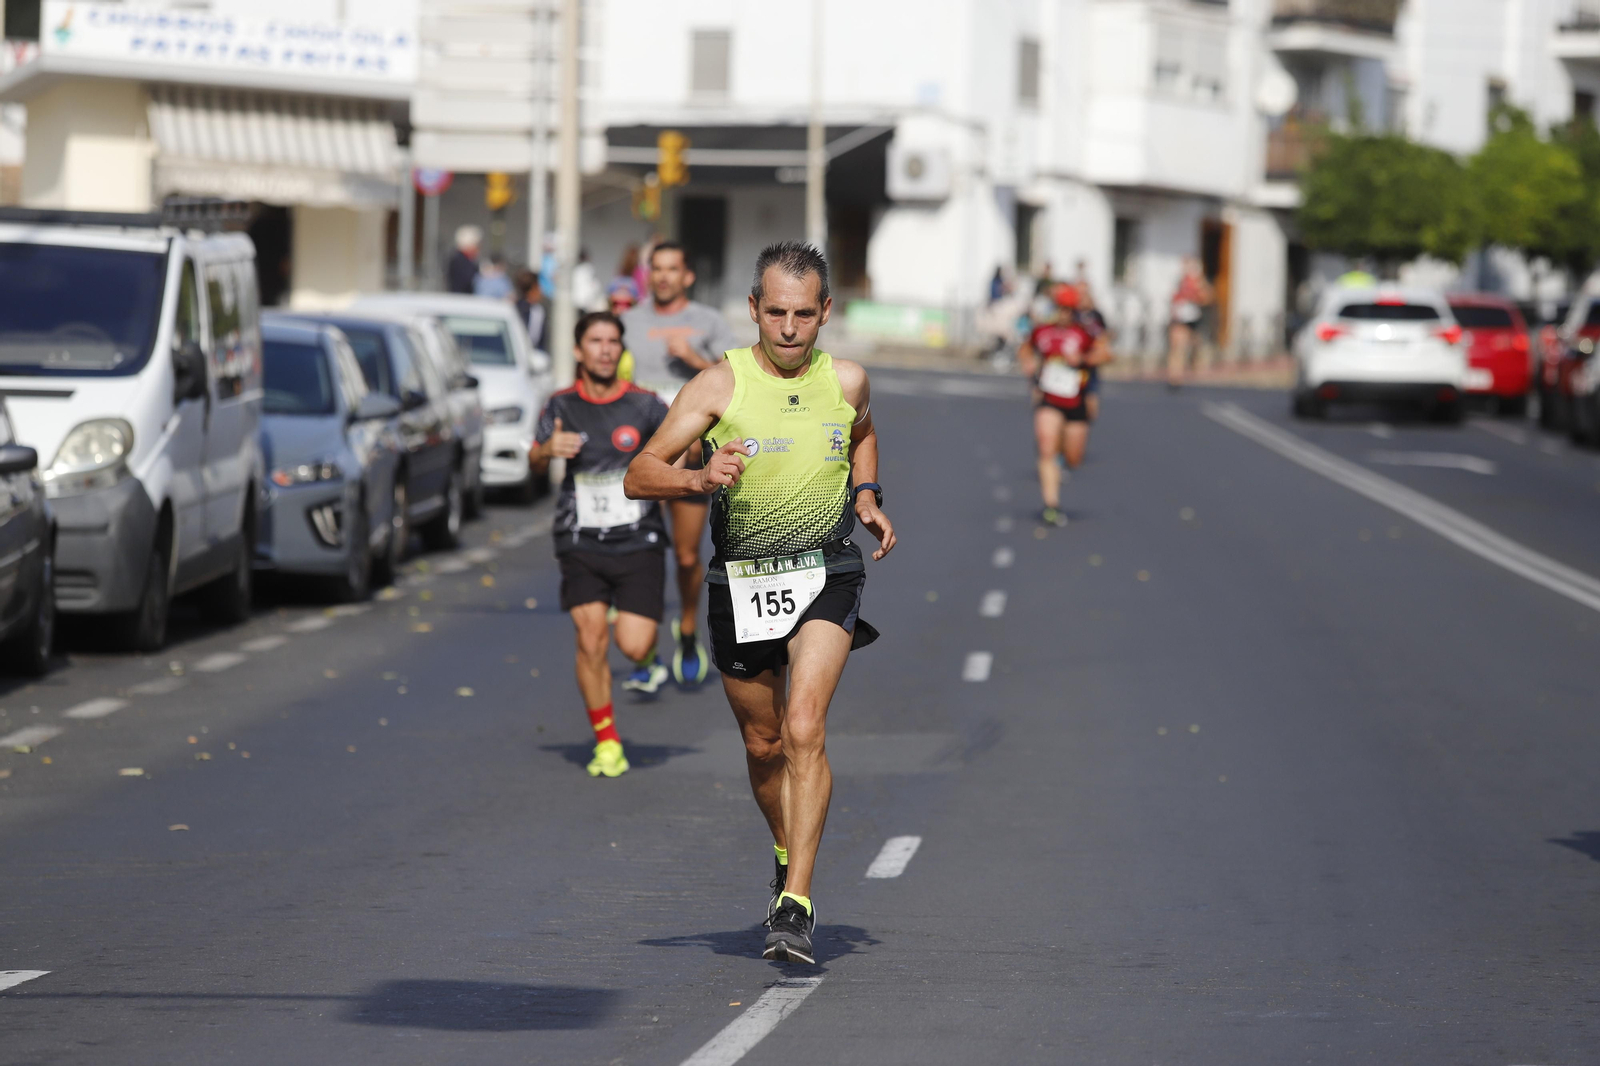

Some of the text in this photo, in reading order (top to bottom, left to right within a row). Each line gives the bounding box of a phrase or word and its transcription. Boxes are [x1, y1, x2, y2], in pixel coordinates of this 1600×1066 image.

[129, 36, 391, 72] PATATAS FRITAS
[762, 437, 795, 446] CLÍNICA
[762, 445, 790, 453] RAGEL
[733, 565, 744, 577] 34
[777, 563, 784, 573] A
[752, 576, 778, 584] RAMON
[750, 588, 796, 618] 155
